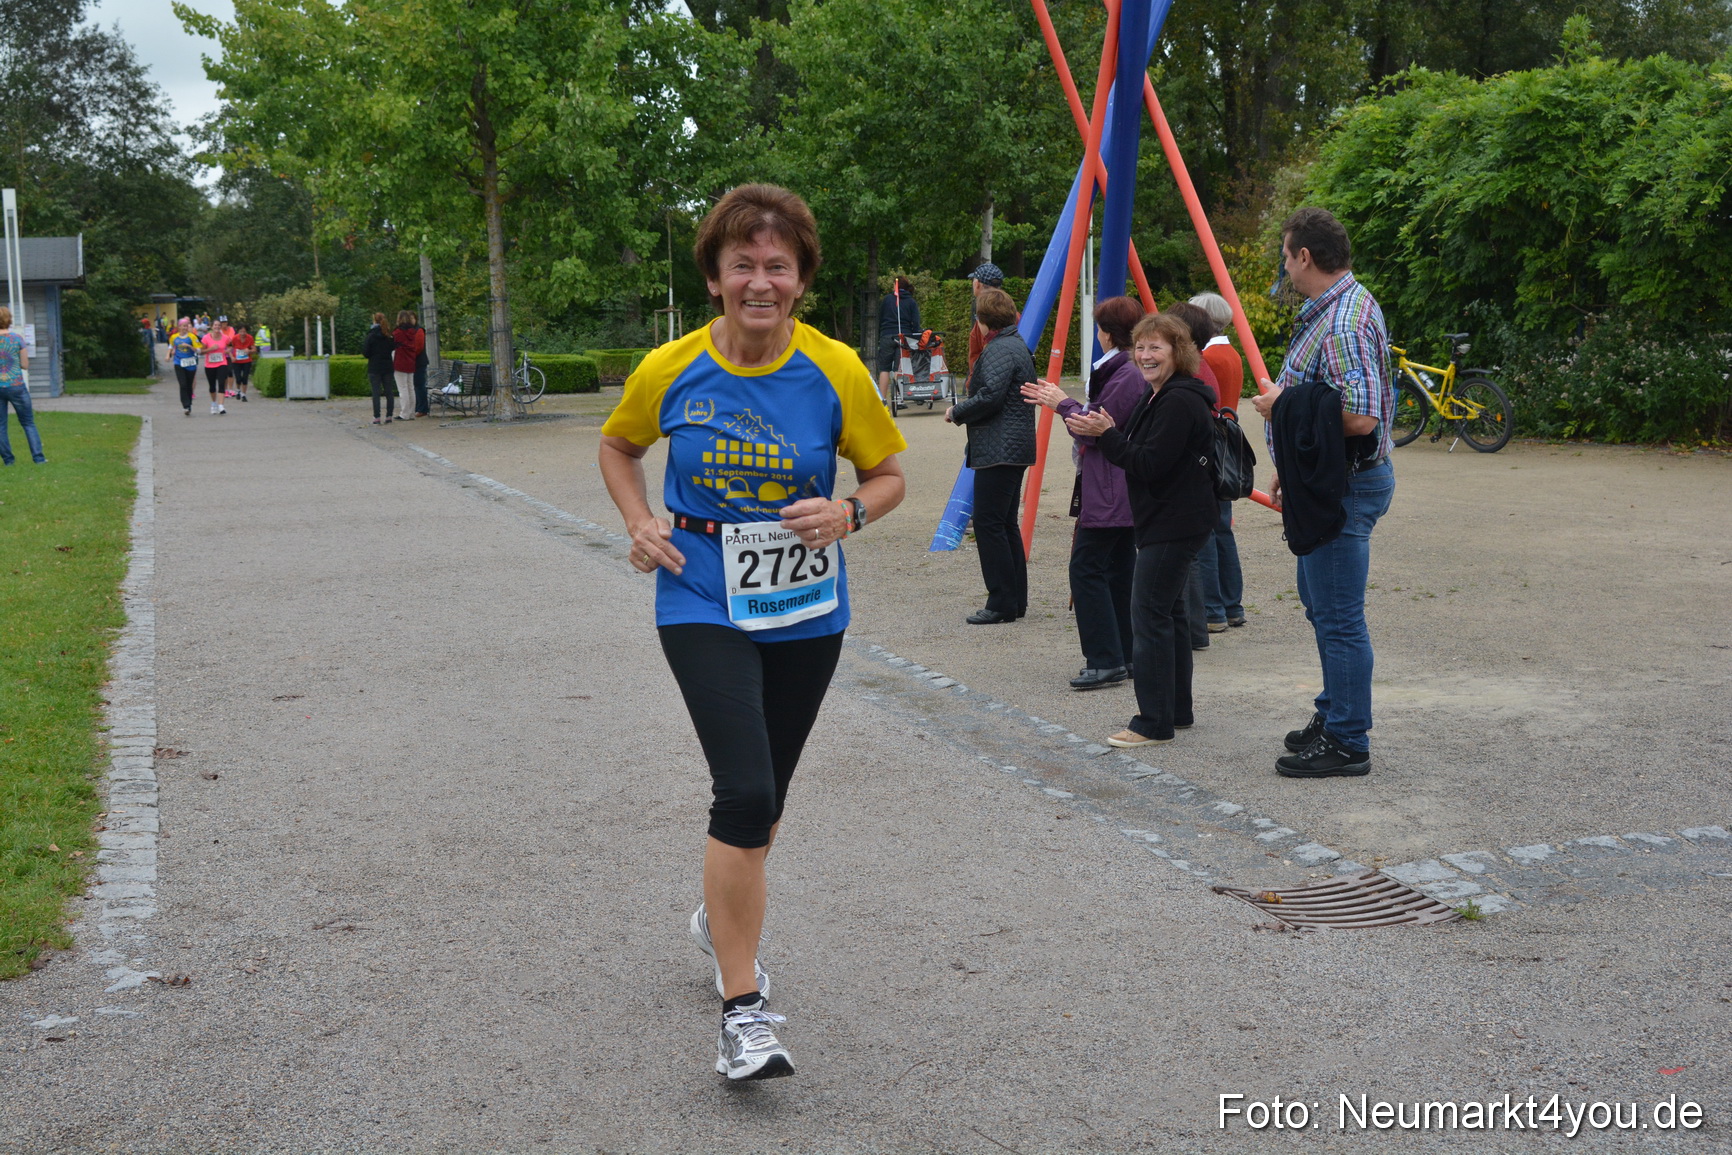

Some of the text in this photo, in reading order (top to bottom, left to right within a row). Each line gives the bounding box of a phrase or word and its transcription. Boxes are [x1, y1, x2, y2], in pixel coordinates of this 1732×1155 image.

[726, 534, 766, 545] PARTL
[738, 543, 829, 588] 2723
[748, 589, 821, 614] Rosemarie
